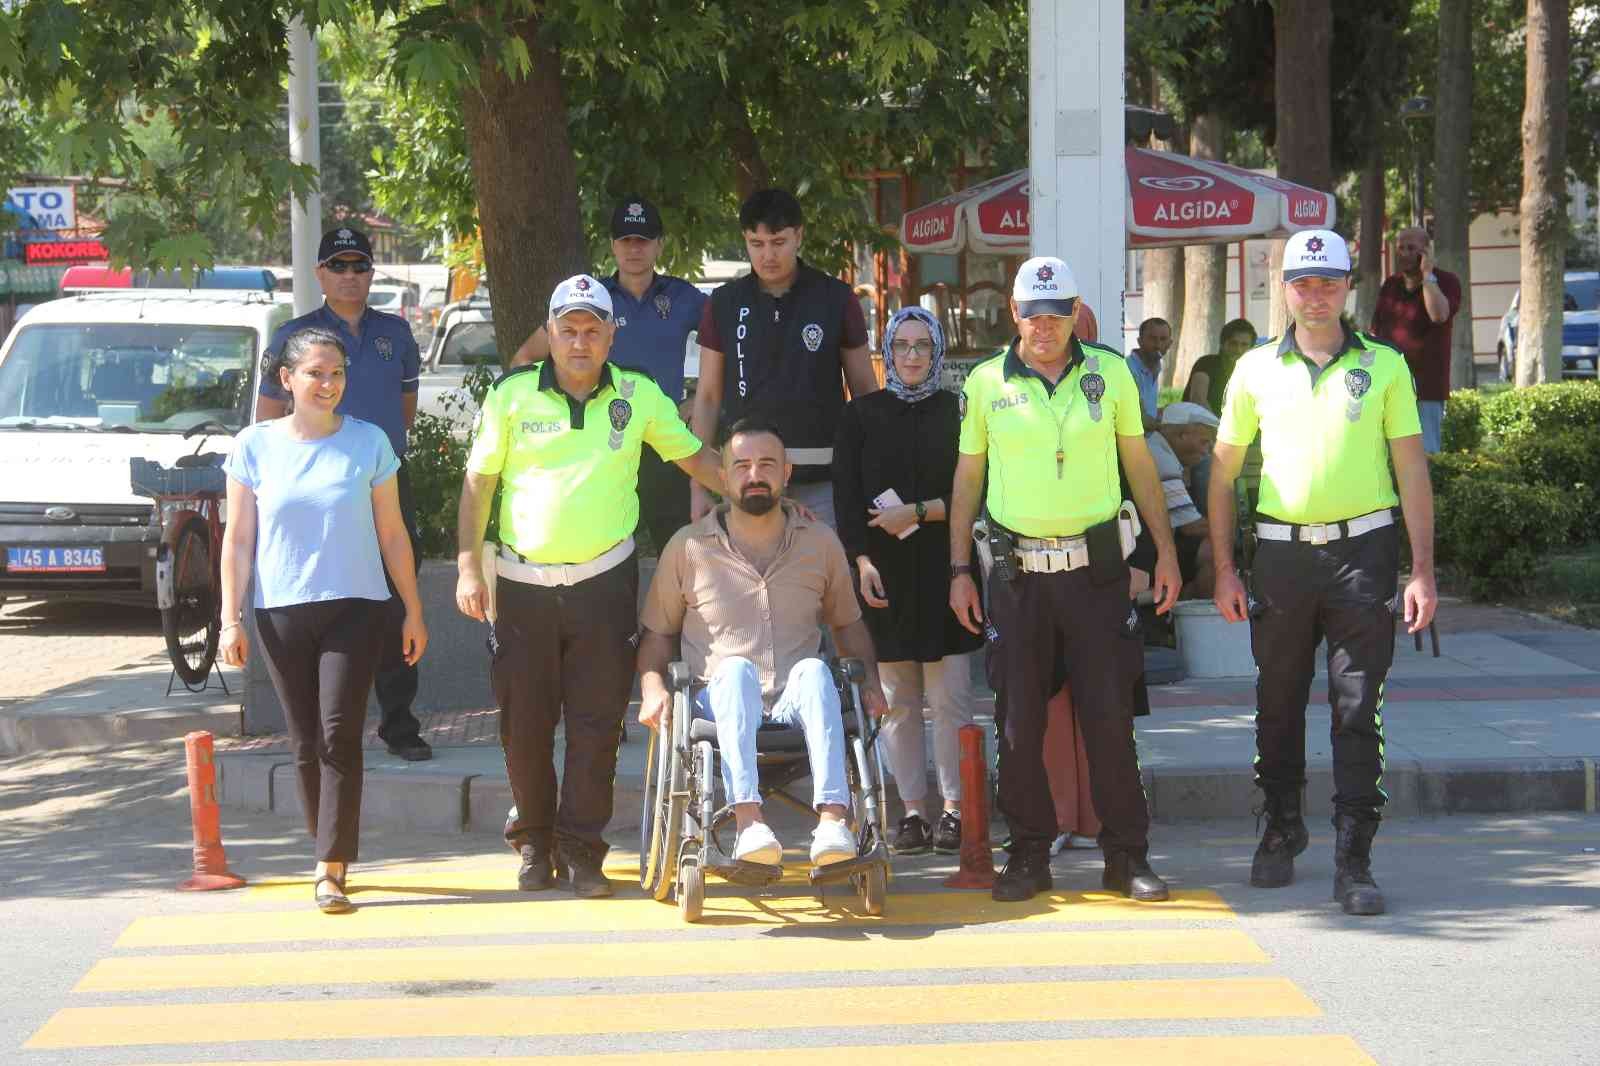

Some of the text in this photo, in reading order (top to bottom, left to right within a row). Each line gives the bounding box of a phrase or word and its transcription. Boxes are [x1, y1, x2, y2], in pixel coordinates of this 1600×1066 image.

[15, 192, 63, 210] TO
[37, 213, 67, 228] MA
[23, 548, 42, 566] 45
[48, 548, 57, 566] A
[63, 548, 102, 566] 8346
